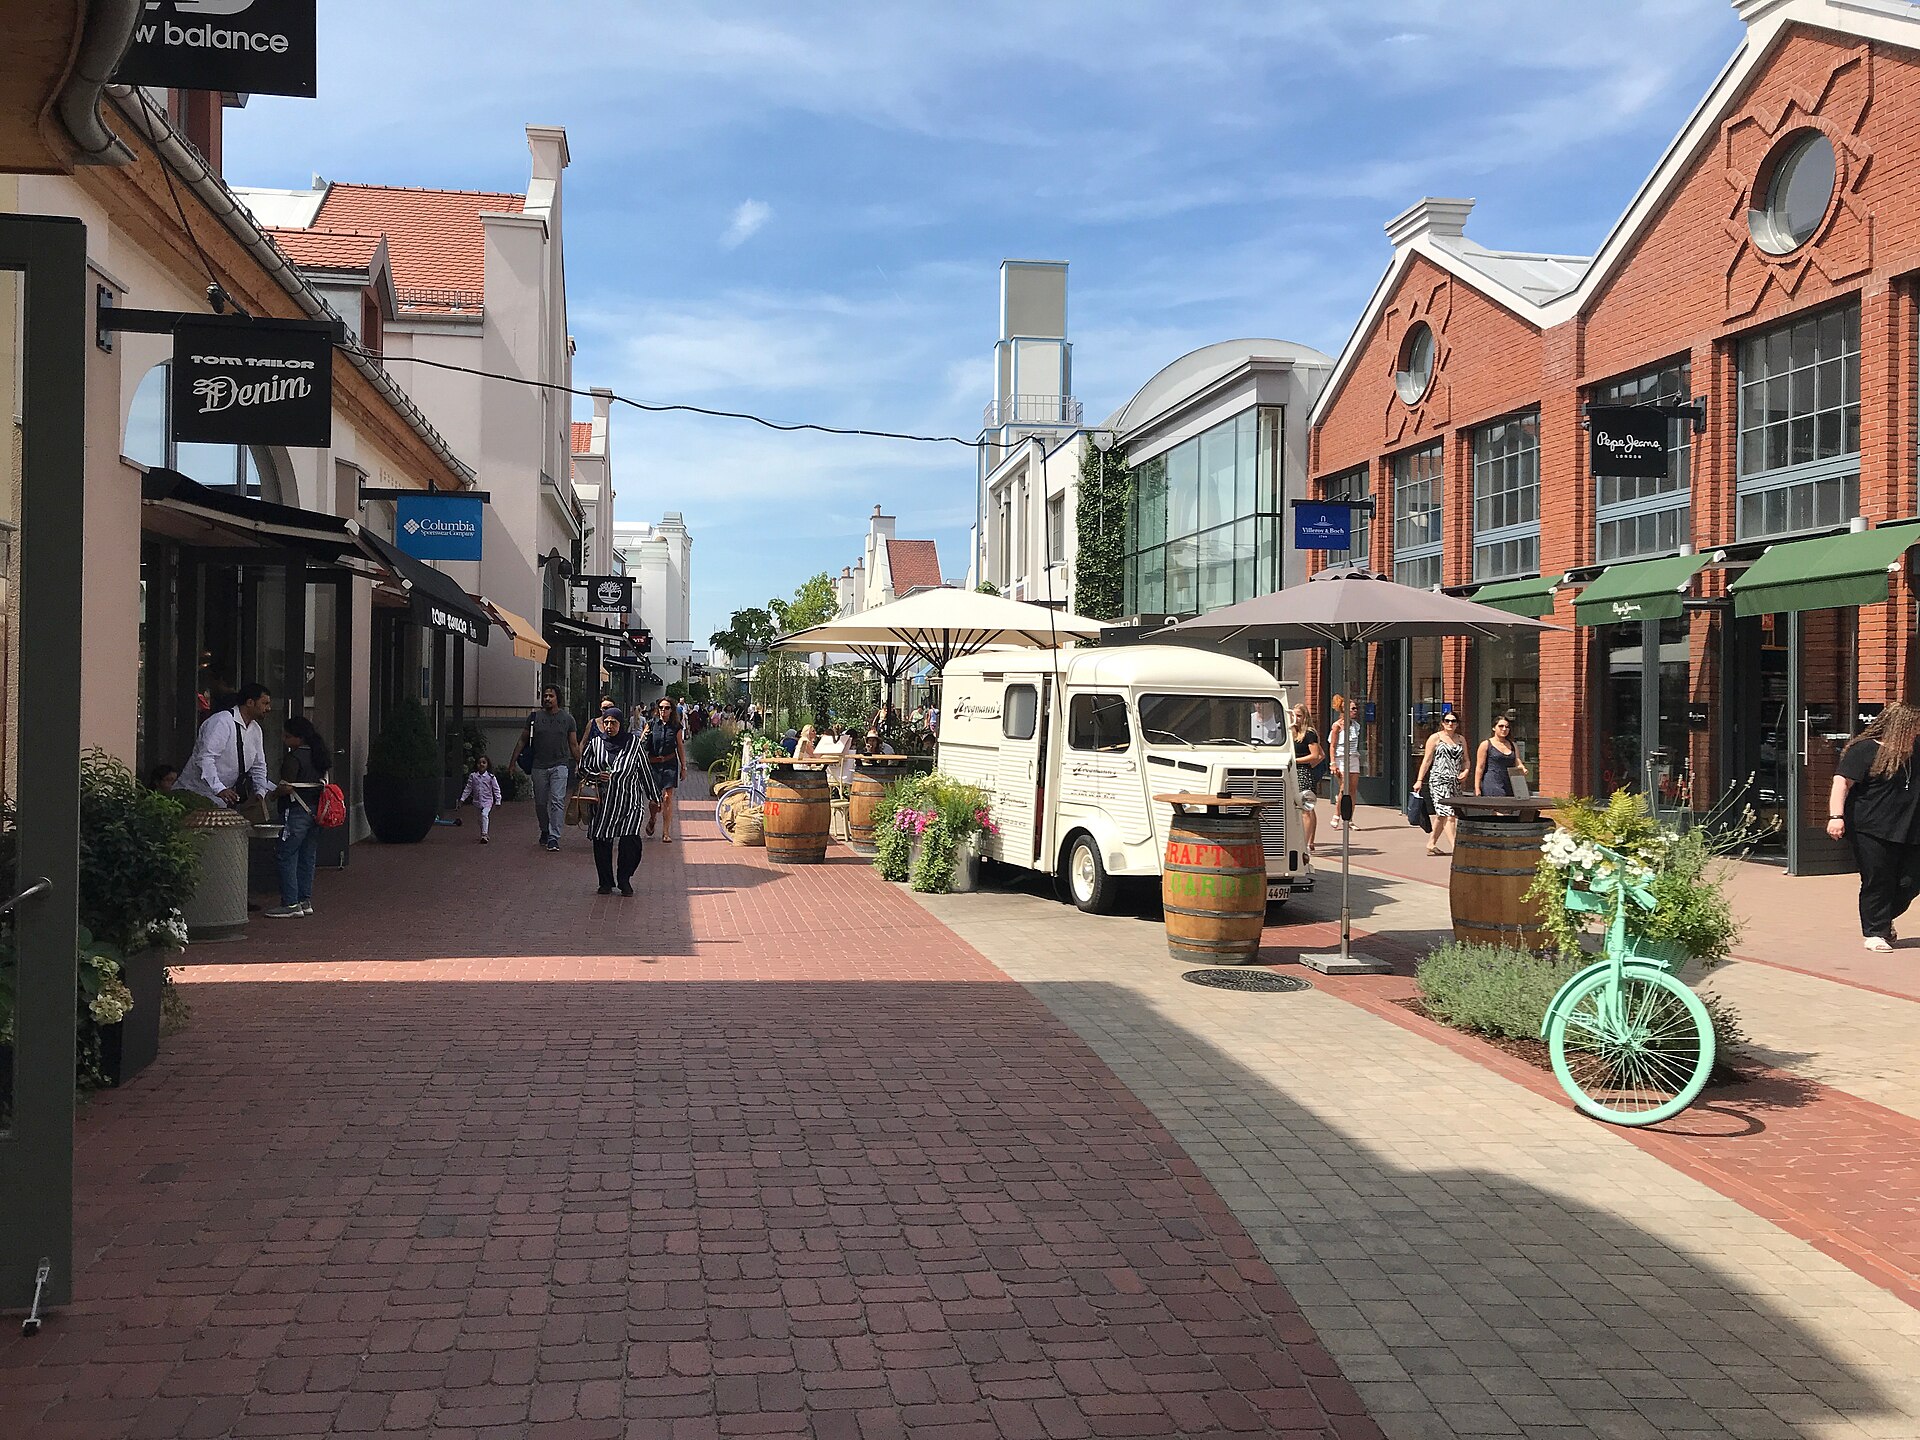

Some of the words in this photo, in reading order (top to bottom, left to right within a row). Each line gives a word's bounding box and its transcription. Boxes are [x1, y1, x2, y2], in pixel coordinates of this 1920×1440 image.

[164, 20, 289, 53] balance
[191, 355, 243, 366] TOM
[245, 358, 315, 369] TAILOR
[193, 374, 312, 414] Denim
[1597, 431, 1626, 452] Pepe
[1624, 434, 1660, 453] Jeans
[420, 518, 475, 532] Columbia
[449, 530, 474, 538] Company
[592, 604, 620, 612] Timberland
[1168, 841, 1223, 867] RAFT
[1268, 887, 1290, 899] 449H
